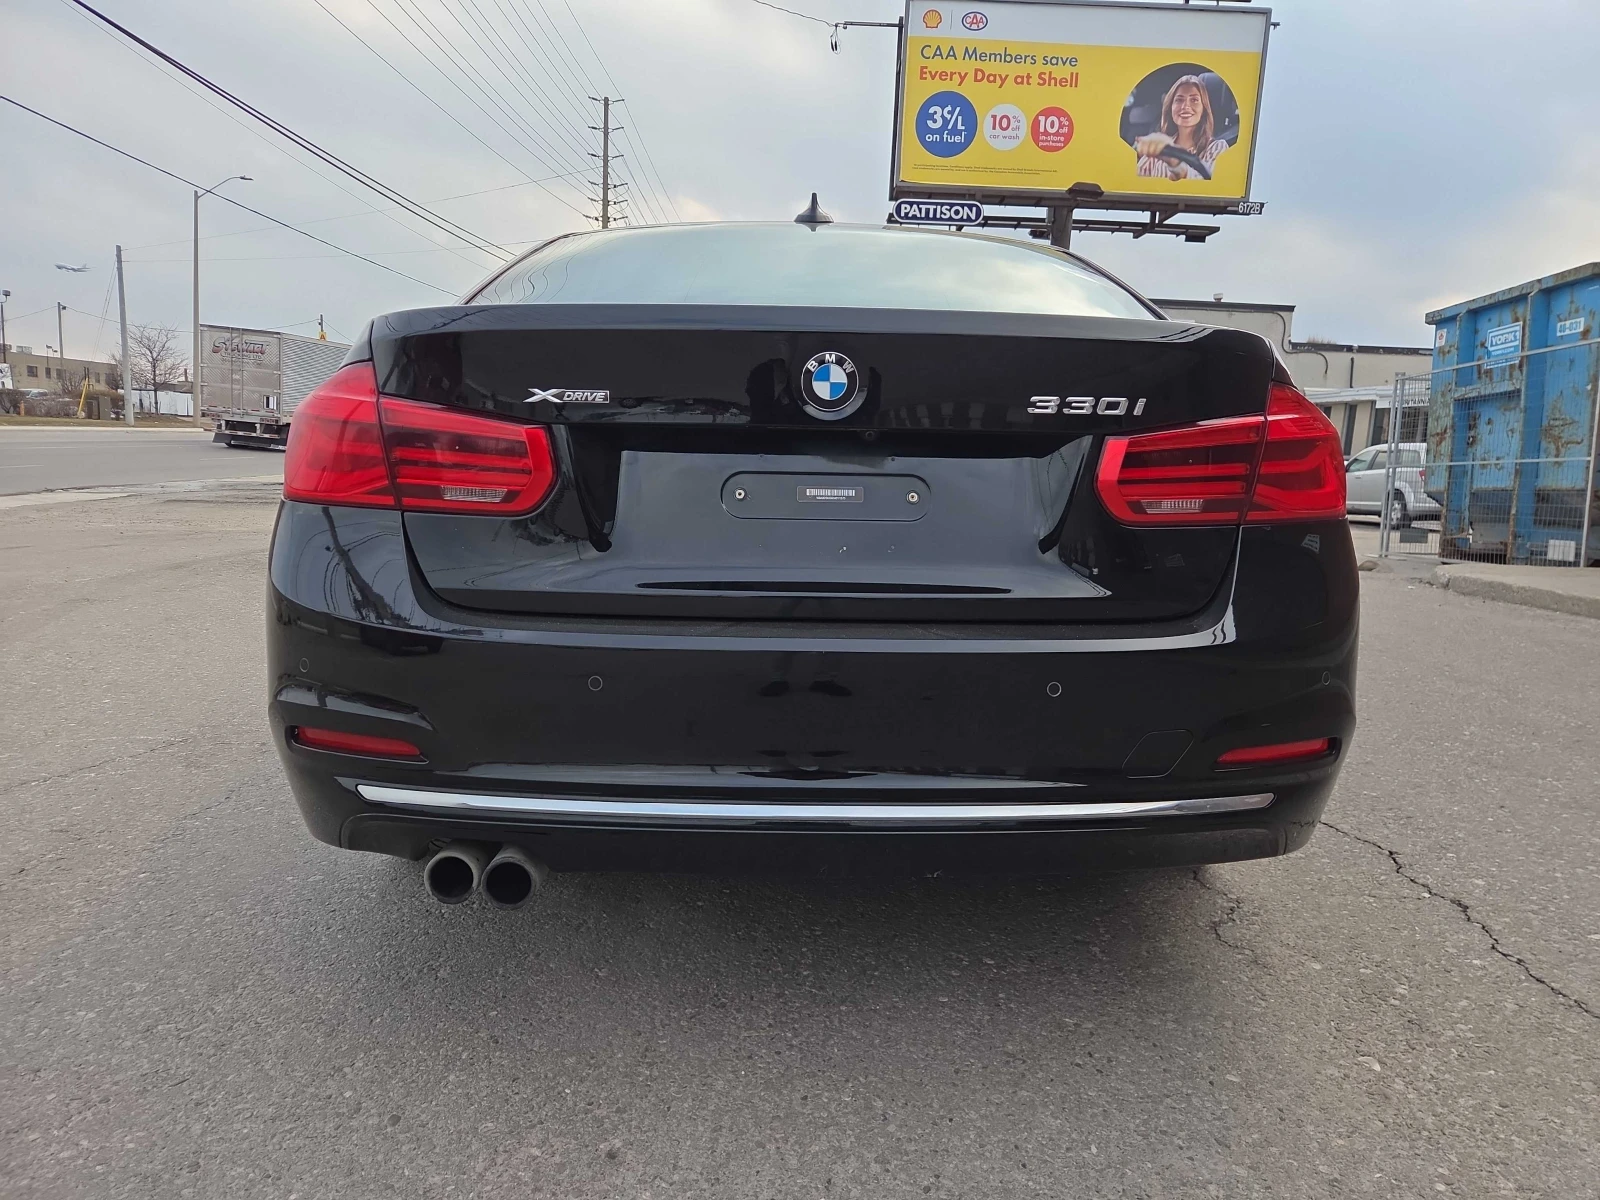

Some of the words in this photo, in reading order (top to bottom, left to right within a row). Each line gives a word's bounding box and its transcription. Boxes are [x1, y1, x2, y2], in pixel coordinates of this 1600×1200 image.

[965, 14, 985, 28] CAA
[920, 44, 958, 61] CAA
[962, 46, 1037, 65] Members
[1042, 55, 1078, 67] save
[919, 66, 969, 86] Every
[973, 68, 1009, 88] Day
[1014, 72, 1032, 86] at
[1037, 71, 1079, 88] Shell
[1059, 126, 1069, 134] off
[925, 134, 940, 143] on
[1002, 133, 1020, 141] wash
[1039, 134, 1065, 142] in-store
[1039, 140, 1064, 148] purchases
[900, 203, 977, 220] PATTISON
[1238, 202, 1261, 214] 6172B
[807, 353, 855, 374] BMW
[1027, 396, 1147, 416] 330i
